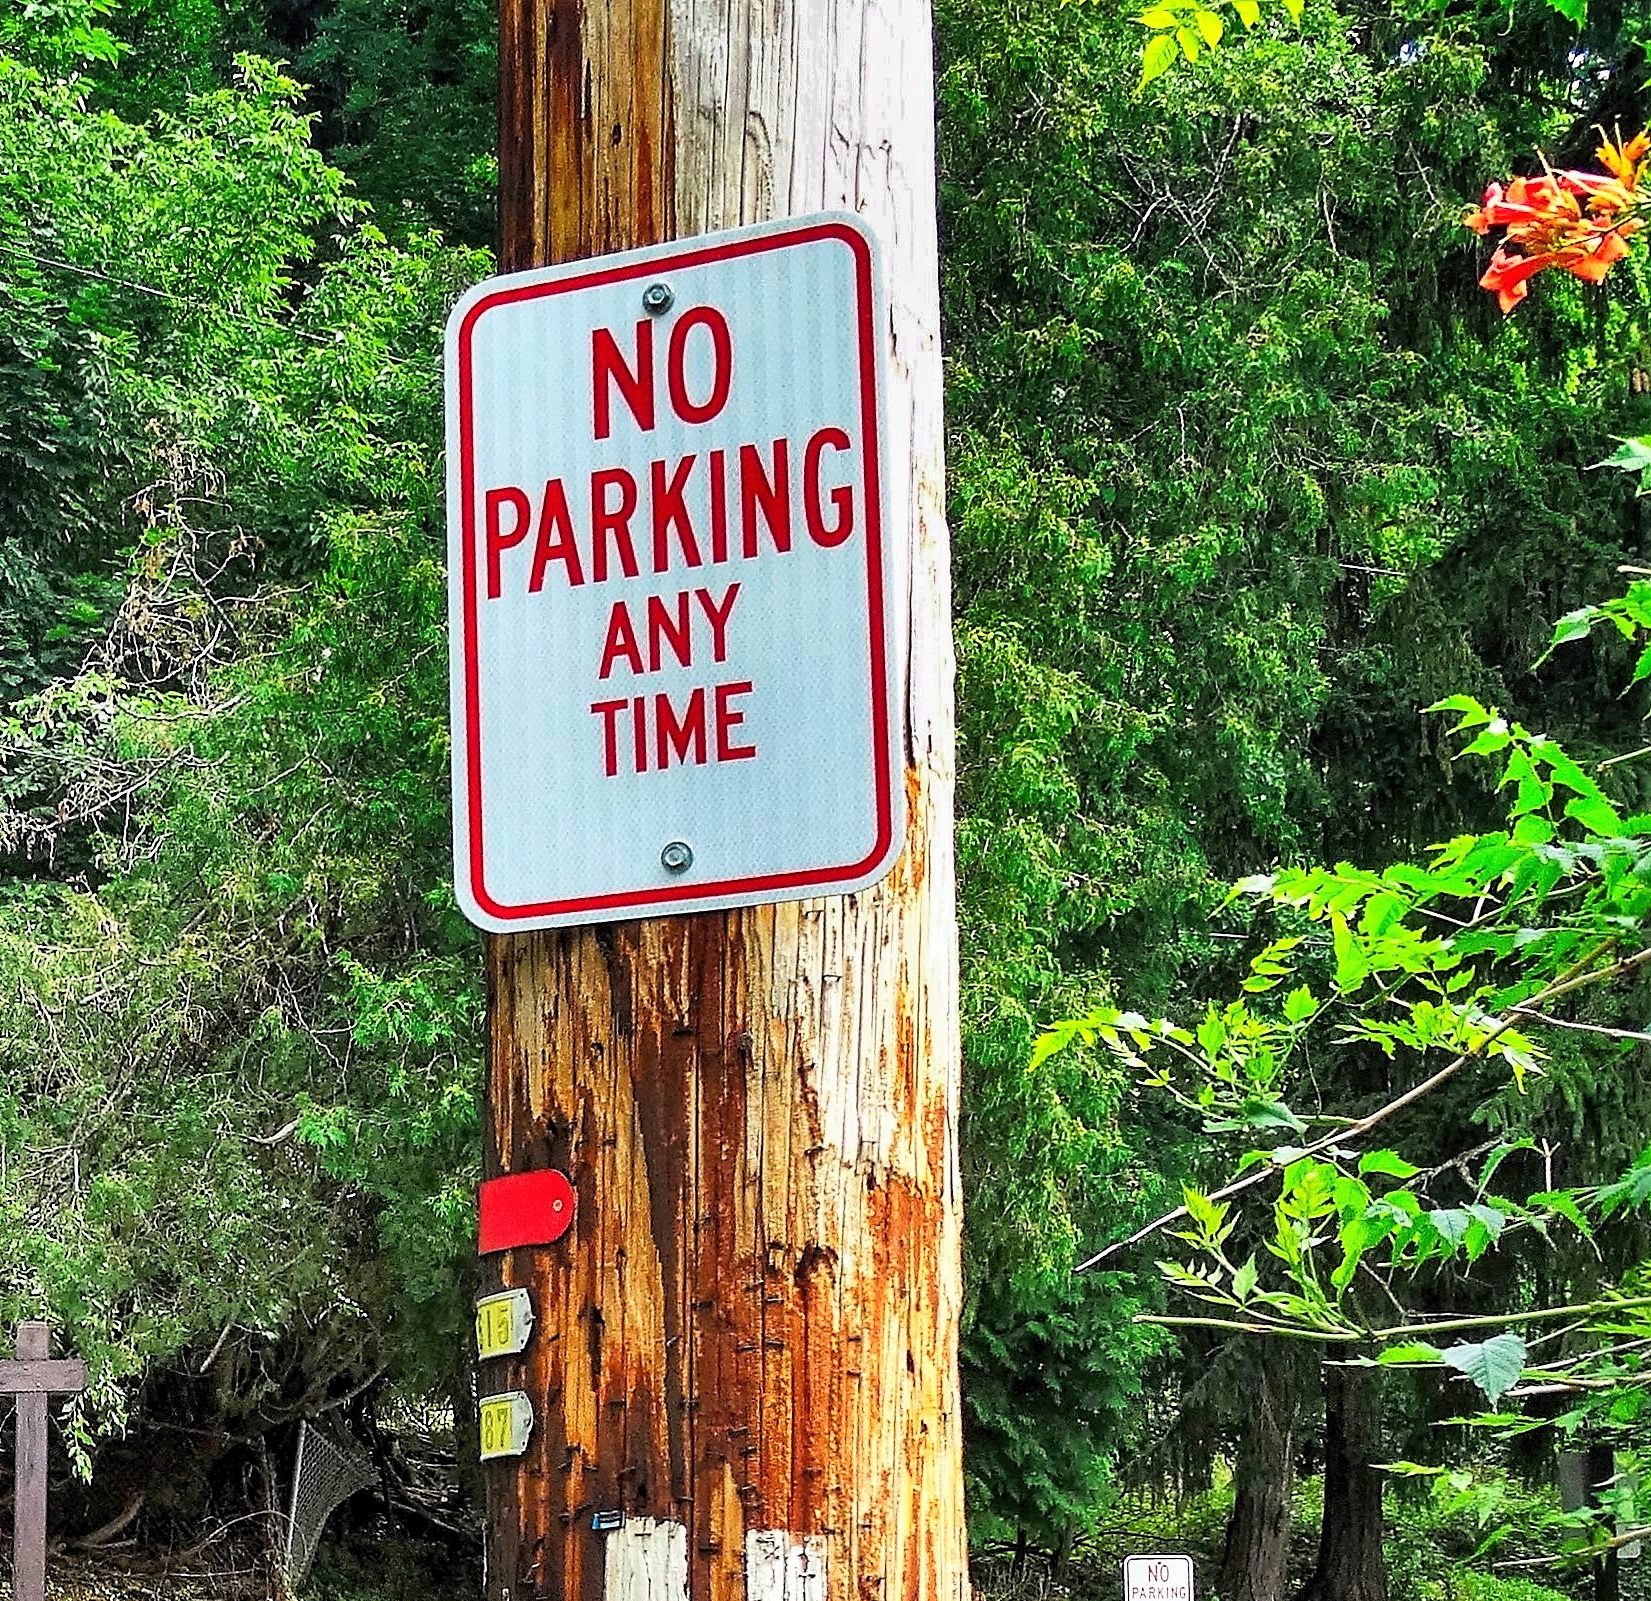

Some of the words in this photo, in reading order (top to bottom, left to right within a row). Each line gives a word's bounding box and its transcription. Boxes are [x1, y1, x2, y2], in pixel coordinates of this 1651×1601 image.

[591, 306, 733, 440] NO
[484, 427, 854, 600] PARKING
[598, 584, 740, 679] ANY
[590, 681, 756, 777] TIME
[1131, 1586, 1187, 1600] PARKING
[1147, 1564, 1170, 1583] NO
